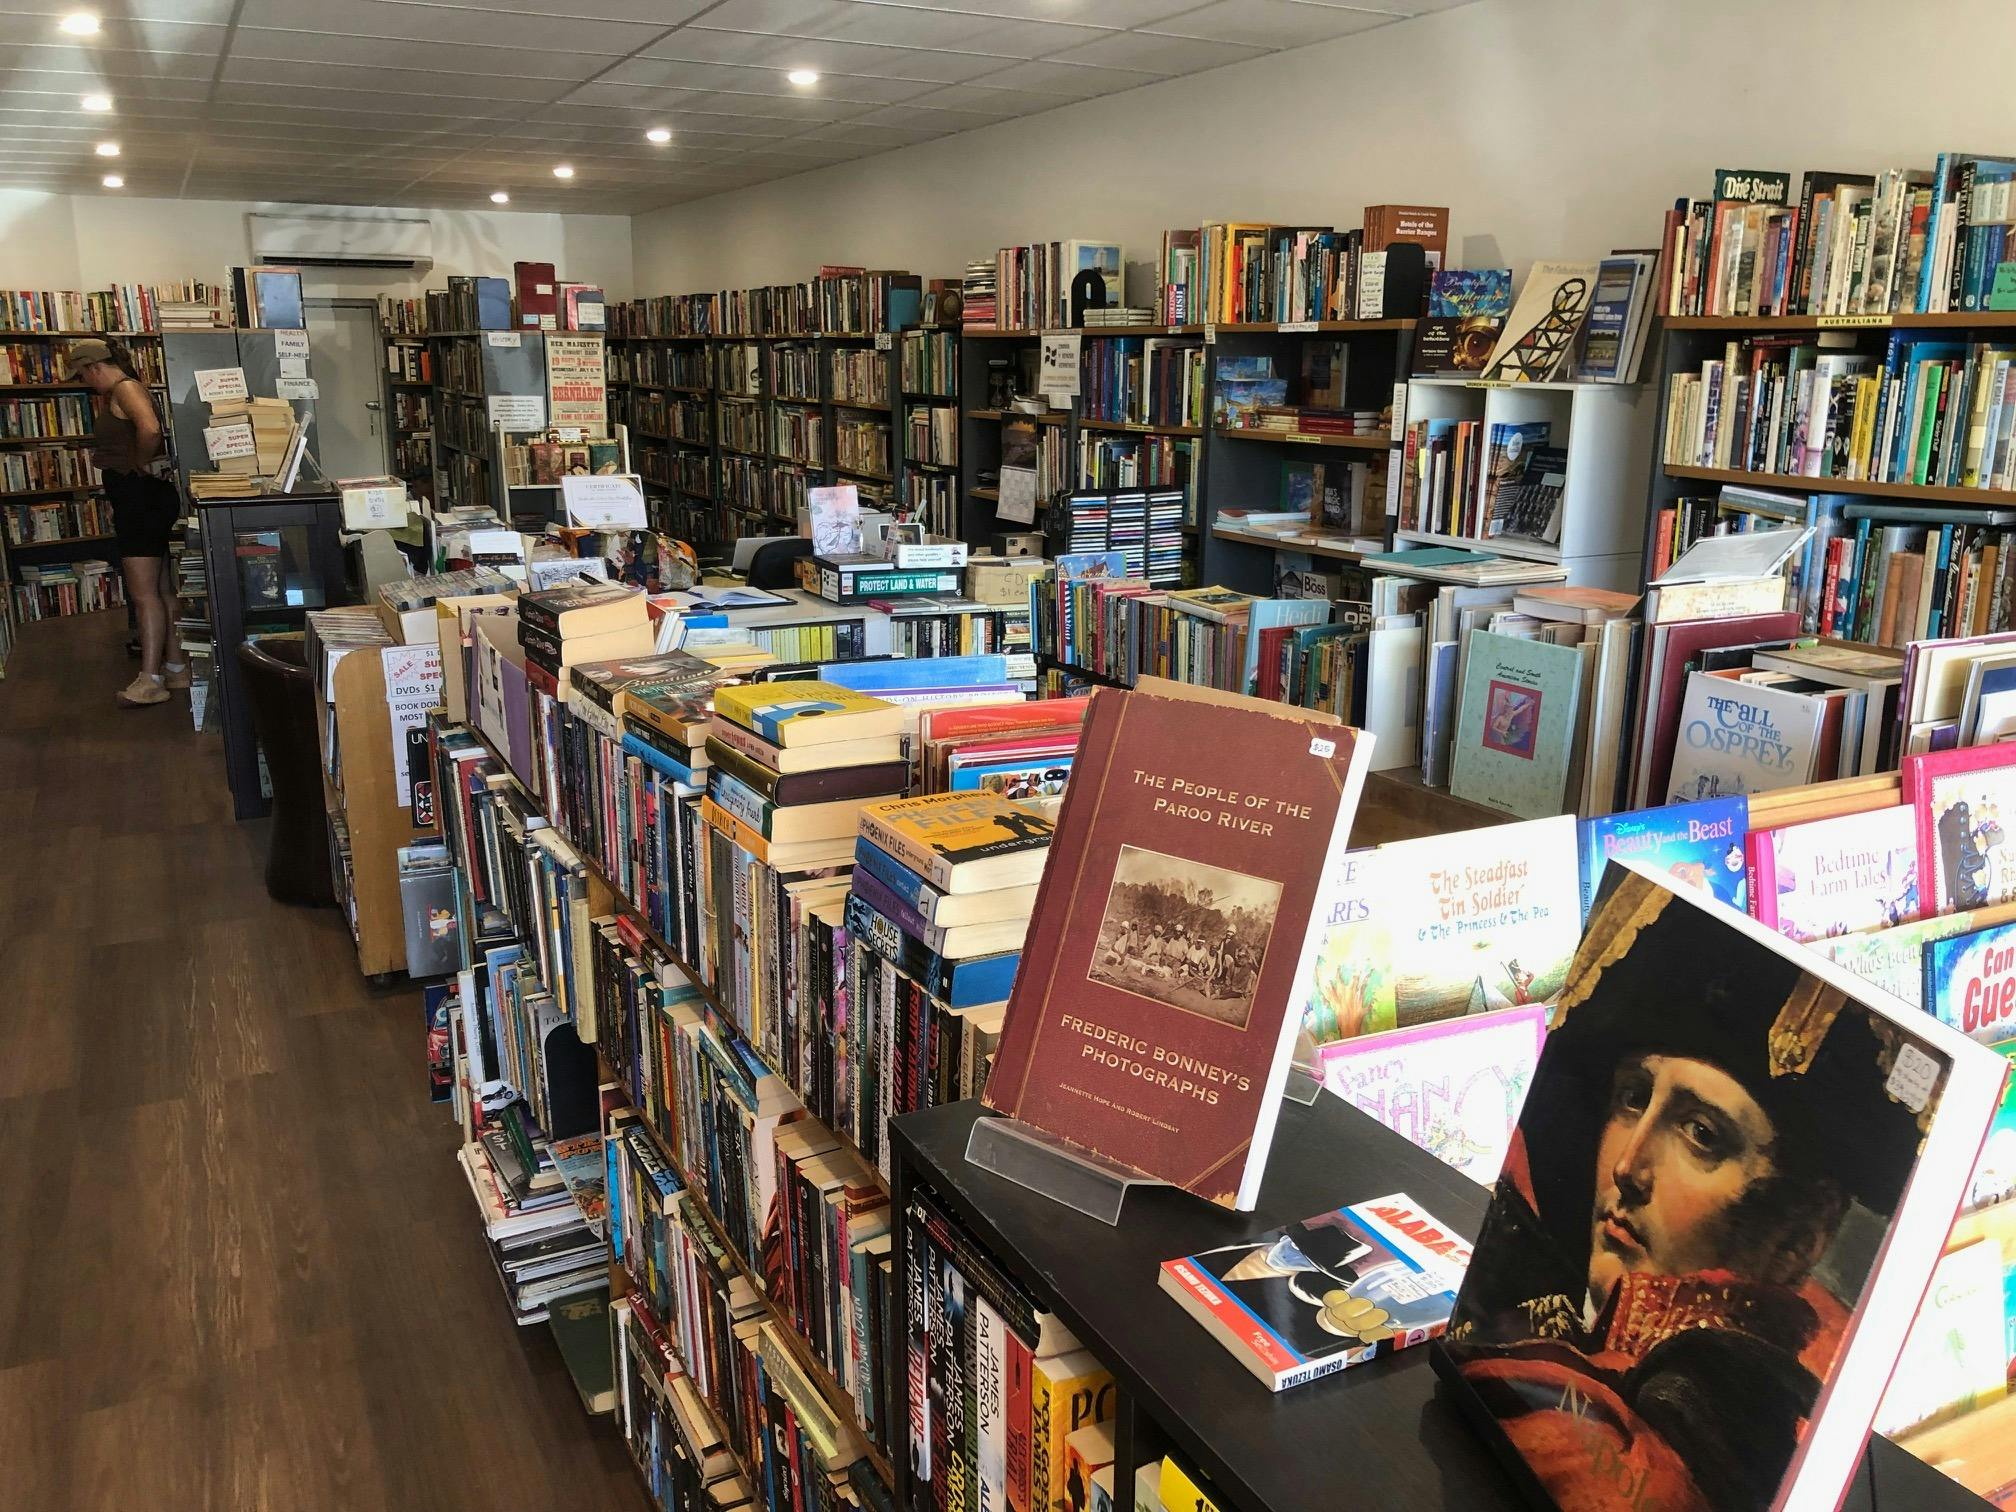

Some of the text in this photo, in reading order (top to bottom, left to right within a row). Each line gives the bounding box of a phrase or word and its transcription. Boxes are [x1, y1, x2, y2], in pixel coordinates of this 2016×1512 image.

[1823, 318, 1883, 327] AUSTRALIANA
[277, 351, 309, 359] SELF-HELP
[226, 441, 254, 449] SPECIAL
[228, 433, 249, 441] SUPER
[859, 577, 937, 592] PROTECT LAND & WATER
[1276, 604, 1322, 626] Heidi
[393, 660, 414, 679] SALE
[395, 684, 436, 695] DVDs $1
[395, 702, 419, 711] BOOK
[400, 713, 424, 722] MOST
[1707, 695, 1736, 713] THE
[1686, 719, 1796, 772] OSPREY
[1737, 719, 1781, 741] OF THE
[879, 790, 992, 812] Chris Morphew
[1132, 769, 1314, 820] THE PEOPLE OF THE
[1153, 797, 1275, 837] PAROO RIVER
[1603, 816, 1733, 859] Beauty and the Beast
[862, 818, 907, 859] PHOENIX FILES
[1428, 856, 1529, 897] The Steadfast
[1747, 866, 1756, 897] Bedtime
[1815, 848, 1880, 876] Bedtime
[740, 872, 748, 920] UNRULY
[1438, 882, 1526, 921] Tin Soldier
[870, 913, 899, 945] HOUSE
[1429, 905, 1550, 939] The Princess The Pea
[867, 927, 899, 963] SECRETS
[1983, 946, 2015, 979] Can
[873, 966, 881, 1020] GHOST
[873, 1030, 881, 1072] BIRD
[1060, 1013, 1252, 1092] FREDERIC BONNEY'S
[1081, 1043, 1220, 1106] PHOTOGRAPHS
[1335, 1056, 1409, 1096] Fancy
[1058, 1082, 1180, 1134] JEANNETTE HOPE AND ROBERT LINDSAY
[906, 1225, 914, 1340] PATTERSON
[913, 1258, 923, 1326] JAMES
[1173, 1263, 1223, 1306] OSAMU TEZUKA
[928, 1245, 937, 1366] PATTERSON
[935, 1275, 945, 1349] JAMES
[853, 1296, 872, 1393] MARCO IMPOSSIBLE
[945, 1318, 955, 1447] PATTERSON
[980, 1311, 990, 1435] PATTERSON
[991, 1347, 1000, 1419] JAMES
[1281, 1358, 1343, 1388] OSAMU TEZUKA
[909, 1345, 925, 1443] REVENGE
[954, 1356, 964, 1434] JAMES
[1041, 1387, 1051, 1443] POP
[1007, 1424, 1018, 1484] TRIAL
[1032, 1404, 1042, 1488] JAMES
